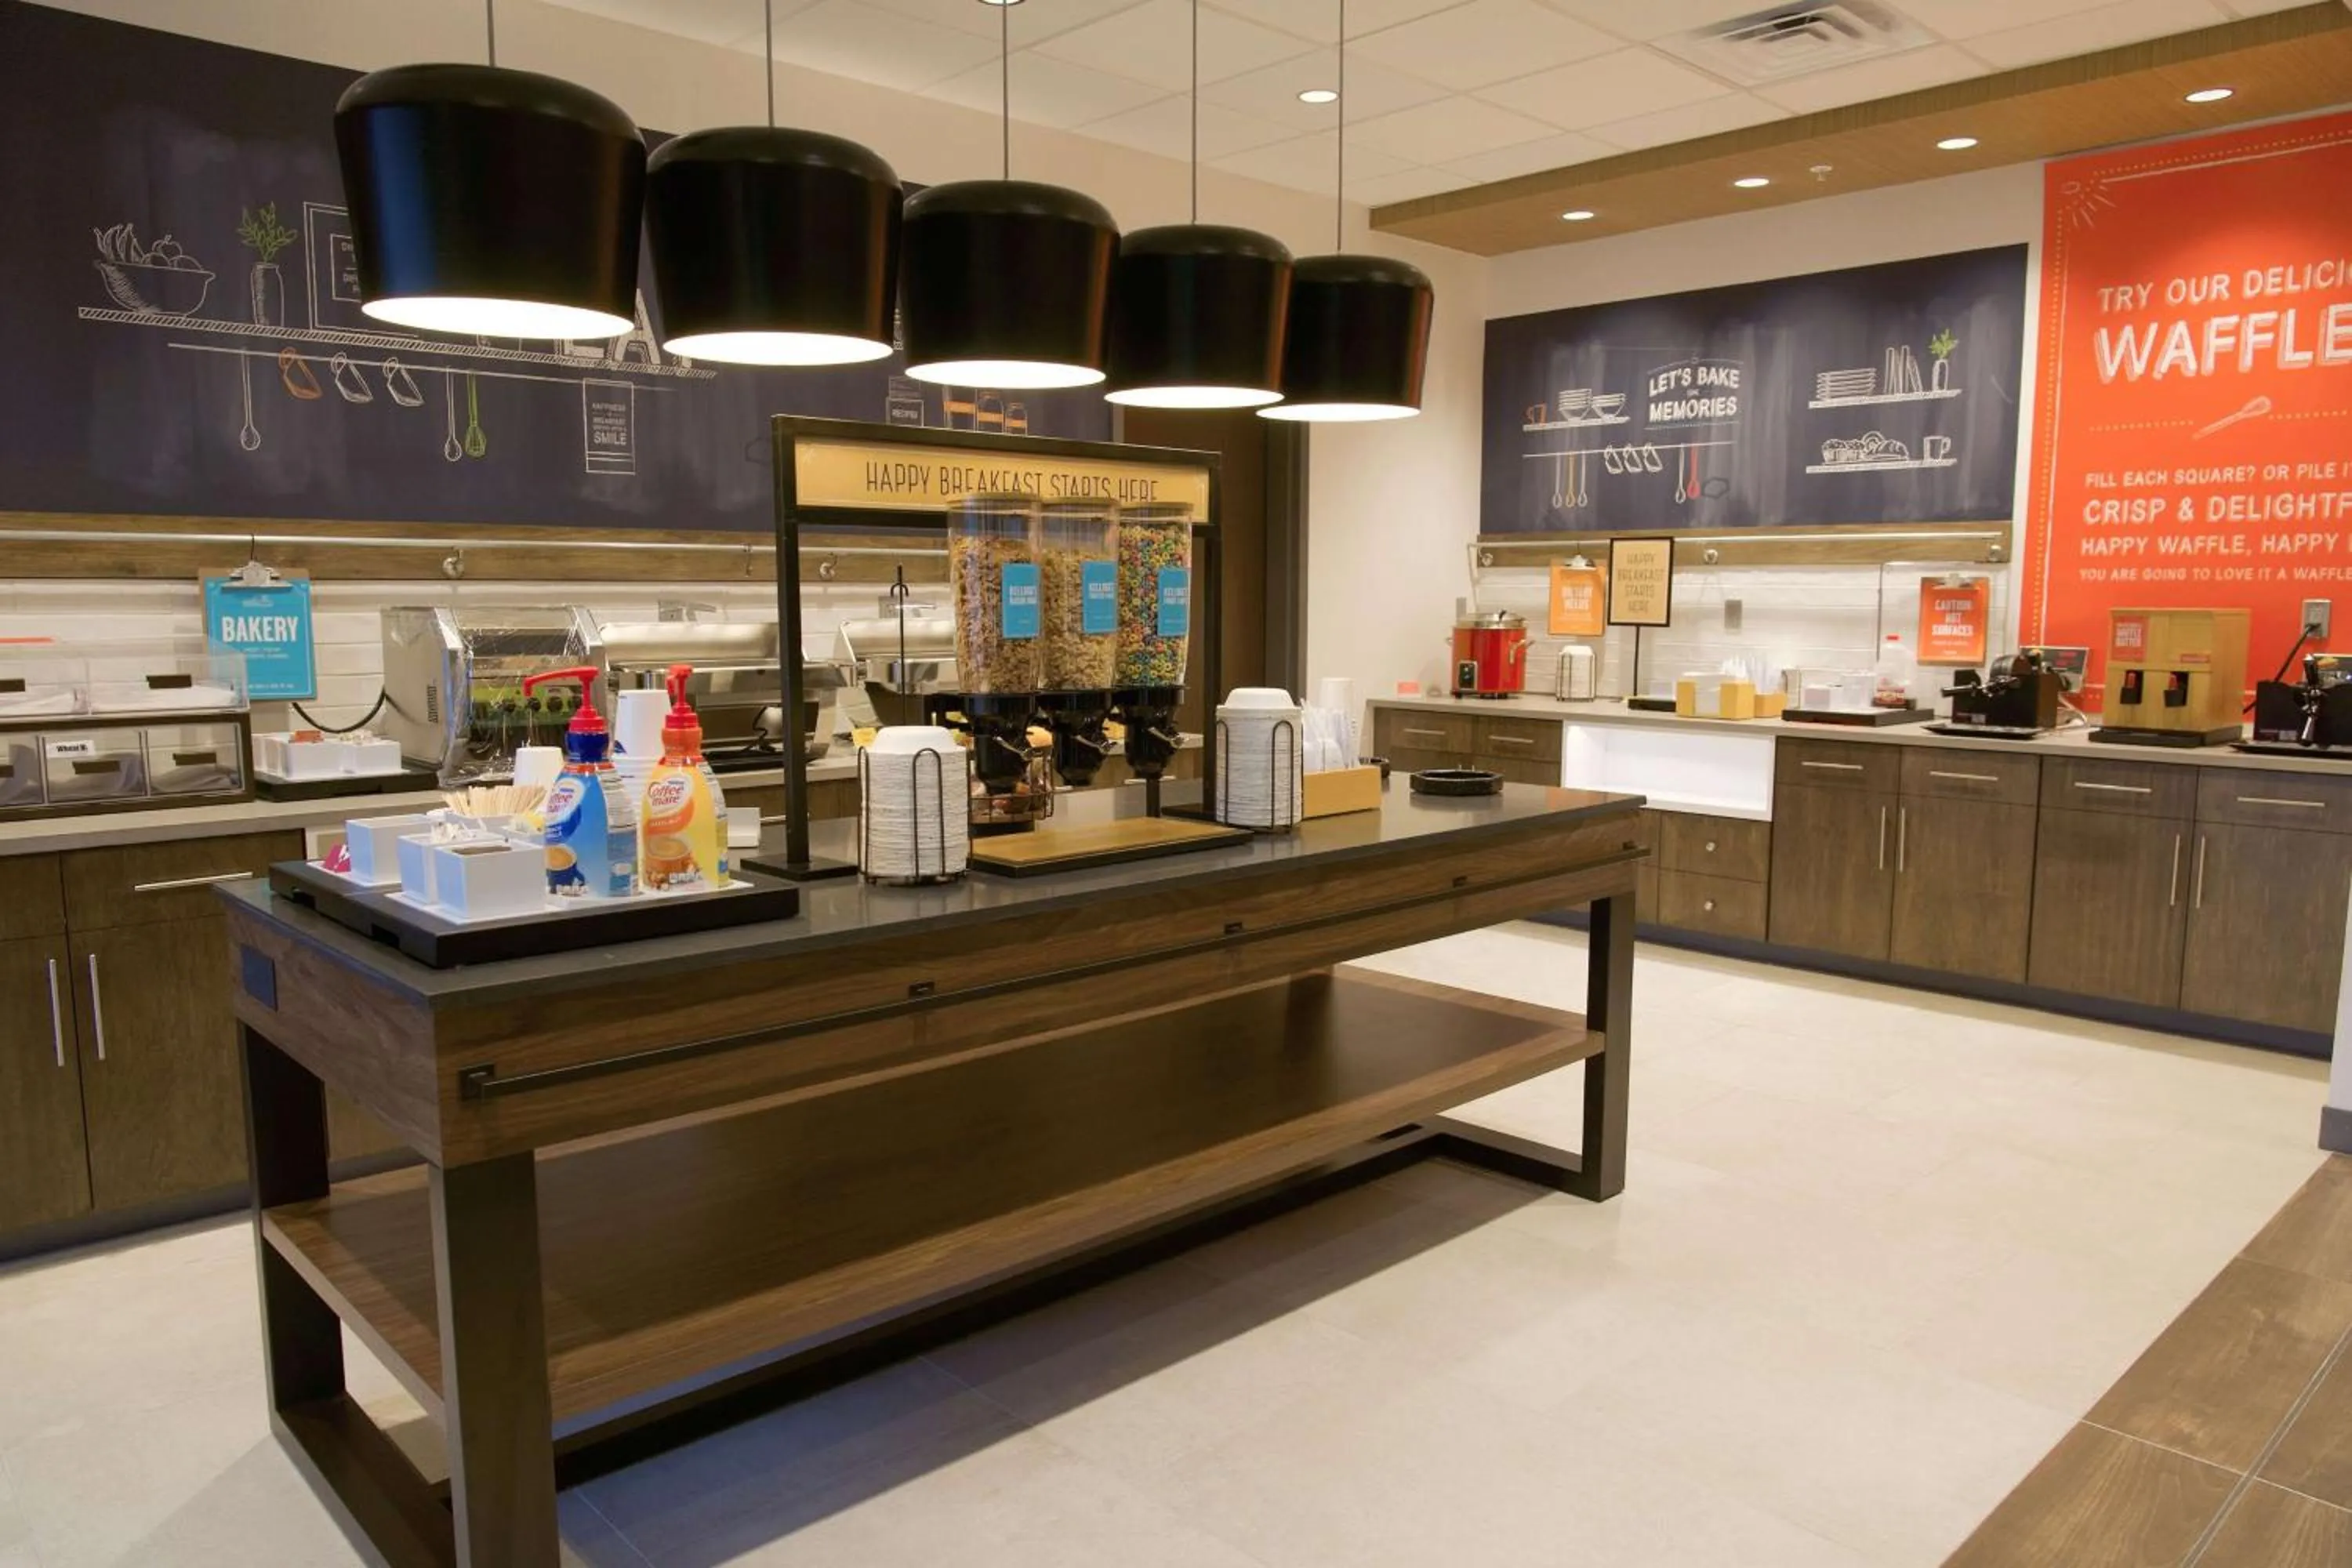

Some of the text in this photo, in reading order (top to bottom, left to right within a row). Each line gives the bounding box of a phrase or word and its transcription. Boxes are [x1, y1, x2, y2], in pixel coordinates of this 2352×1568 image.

[2097, 258, 2352, 312] TRY OUR DELICI
[1649, 366, 1740, 397] LET'S BAKE
[1650, 396, 1737, 422] MEMORIES
[593, 431, 626, 445] SMILE
[866, 462, 1160, 503] HAPPY BREAKFAST STARTS HERE
[2085, 461, 2352, 488] FILL EACH SQUARE? OR PILE I
[2083, 492, 2352, 524] CRISP & DELIGHTF
[2080, 536, 2149, 556] HAPPY
[2158, 535, 2252, 556] WAFFLE,
[2261, 532, 2339, 554] HAPPY
[1626, 553, 1656, 563] HAPPY
[1617, 568, 1664, 581] BREAKFAST
[2079, 568, 2107, 581] YOU
[2111, 568, 2136, 580] ARE
[2142, 568, 2187, 581] GOING
[2192, 568, 2211, 581] TO
[2216, 567, 2253, 580] LOVE
[2258, 567, 2271, 580] IT
[2276, 566, 2287, 579] A
[1625, 584, 1654, 597] STARTS
[1628, 601, 1650, 612] HERE
[222, 616, 299, 642] BAKERY
[648, 782, 684, 798] Coffee
[652, 797, 679, 806] mate
